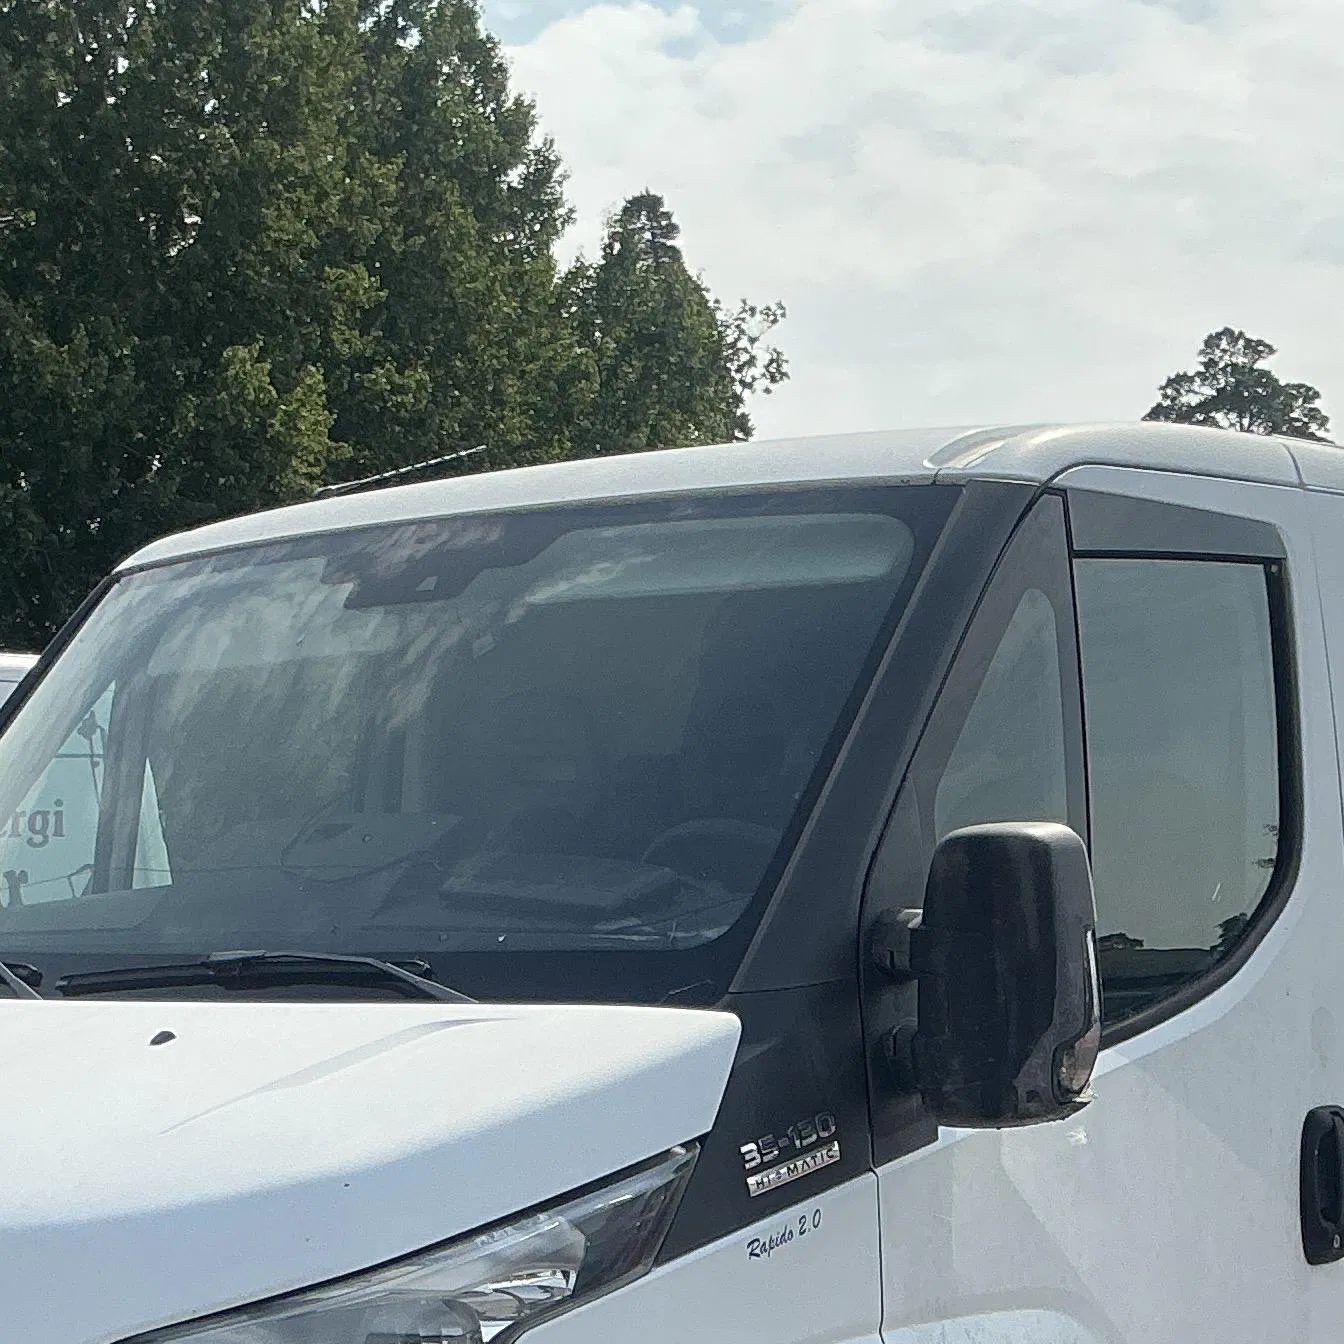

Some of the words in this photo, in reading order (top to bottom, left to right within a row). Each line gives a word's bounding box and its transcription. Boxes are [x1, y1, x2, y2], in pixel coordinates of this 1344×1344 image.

[740, 1111, 837, 1170] 35-130
[746, 1224, 794, 1260] Rapido
[798, 1208, 822, 1238] 2.0
